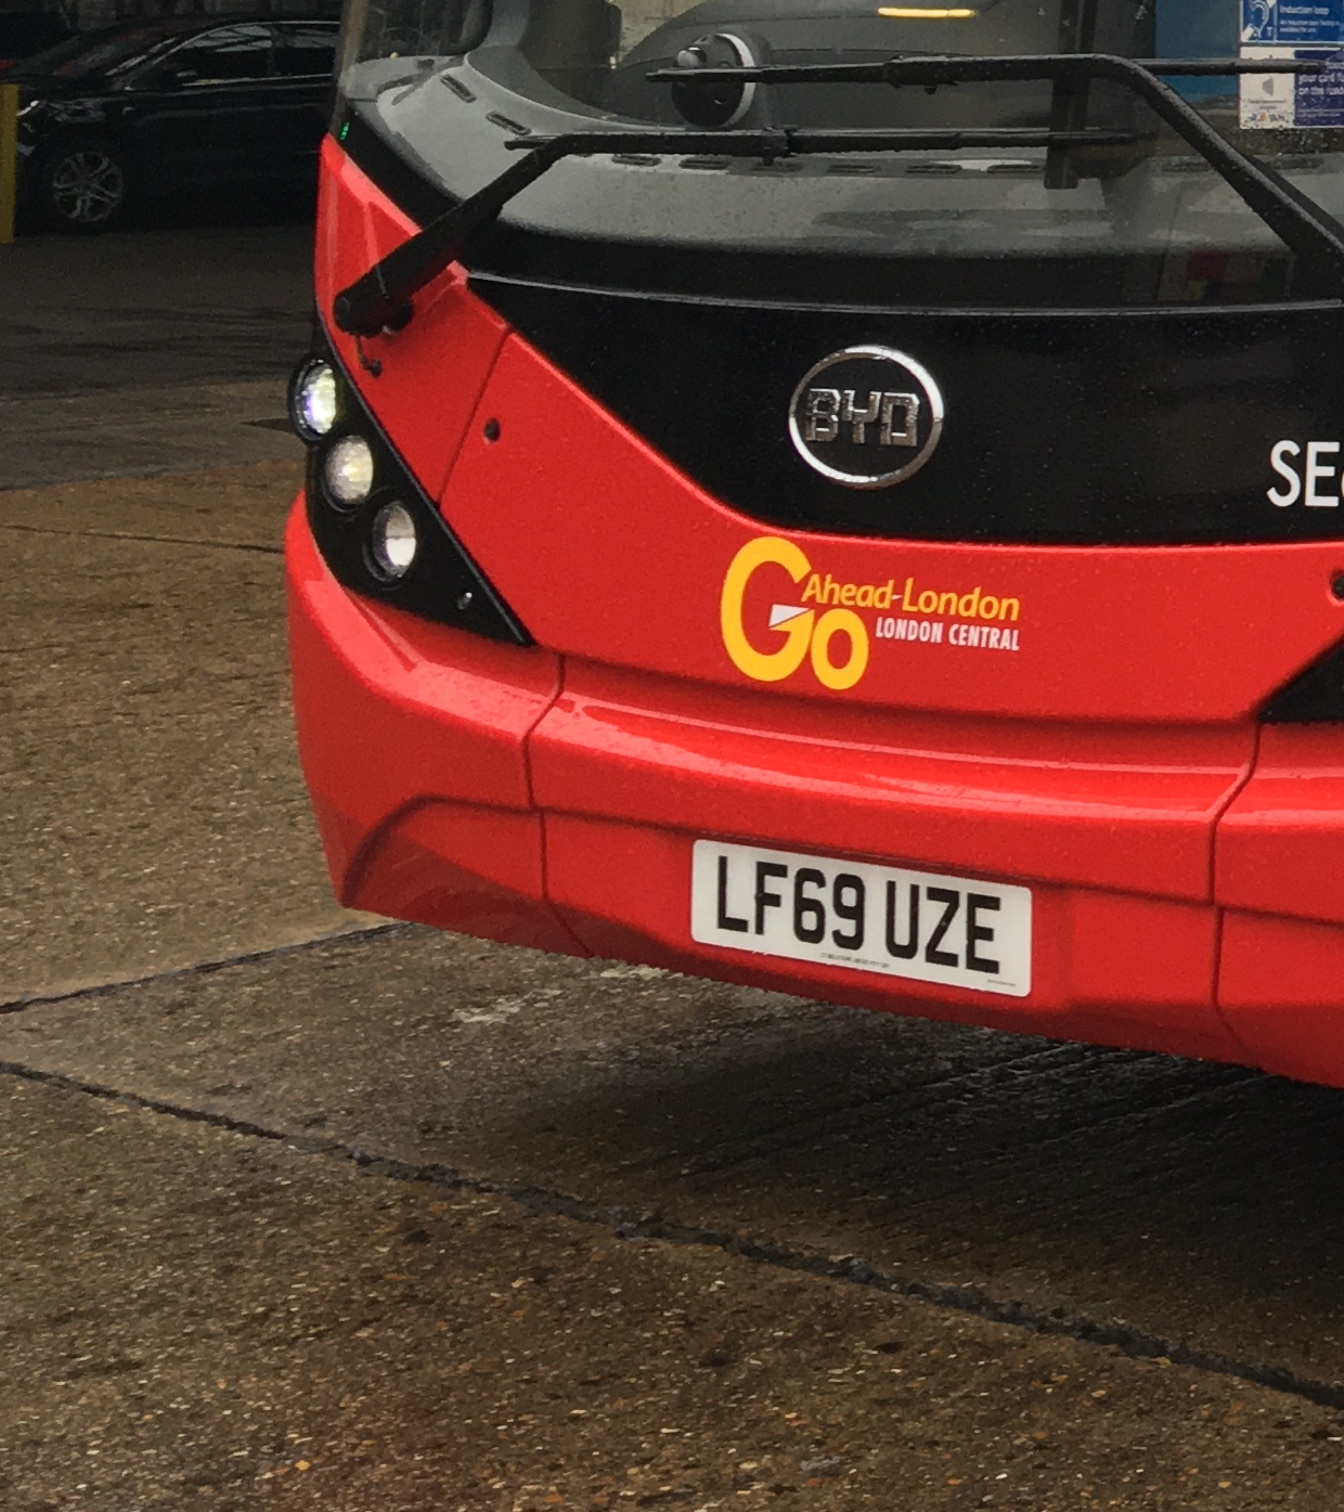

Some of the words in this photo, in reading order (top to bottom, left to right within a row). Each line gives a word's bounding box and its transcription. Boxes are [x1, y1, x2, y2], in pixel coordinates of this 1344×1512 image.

[805, 388, 920, 447] BYD
[720, 536, 870, 690] Go
[801, 574, 1020, 621] Ahead-London
[876, 616, 944, 644] LONDON
[948, 622, 1020, 651] CENTRAL
[717, 855, 866, 951] LF69
[885, 880, 1001, 975] UZE
